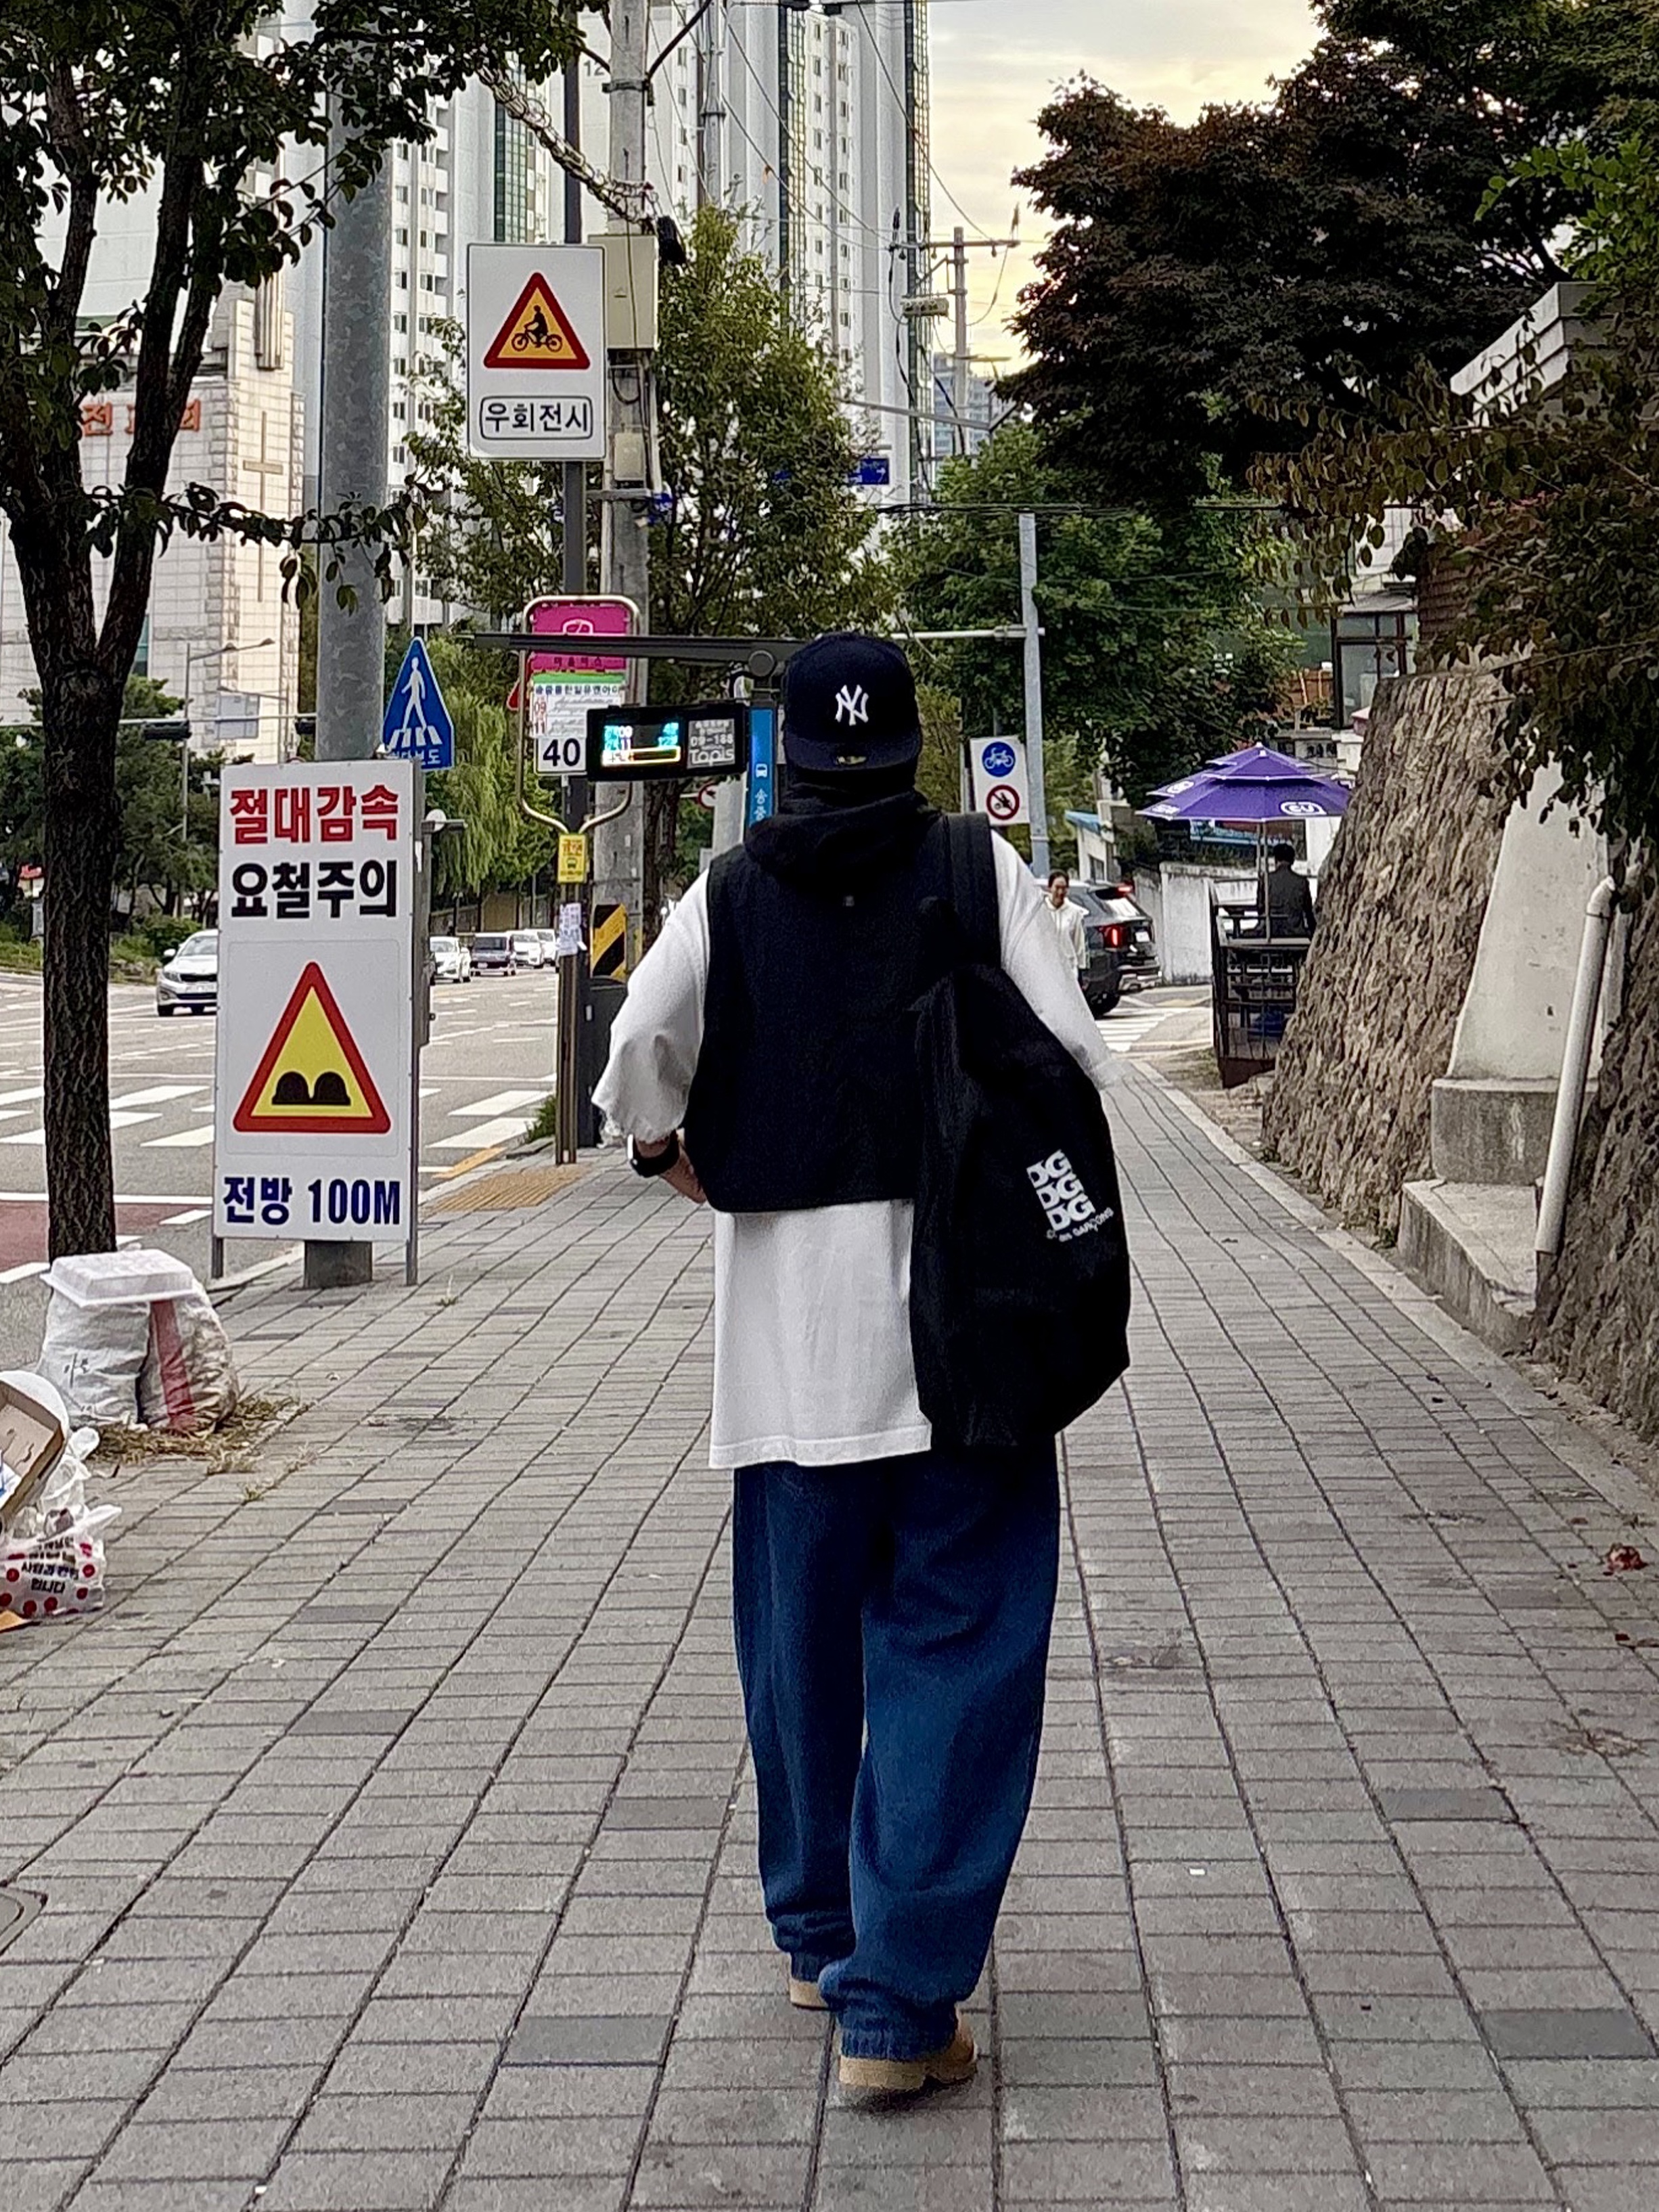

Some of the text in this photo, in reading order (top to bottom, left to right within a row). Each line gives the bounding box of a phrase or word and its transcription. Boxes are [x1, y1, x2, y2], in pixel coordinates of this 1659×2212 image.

[484, 401, 589, 433] 우회전시
[835, 684, 869, 726] NY
[543, 738, 581, 767] 40
[230, 784, 399, 844] 절대감속
[231, 859, 397, 919] 요철주의
[223, 1176, 401, 1225] 전방 100M
